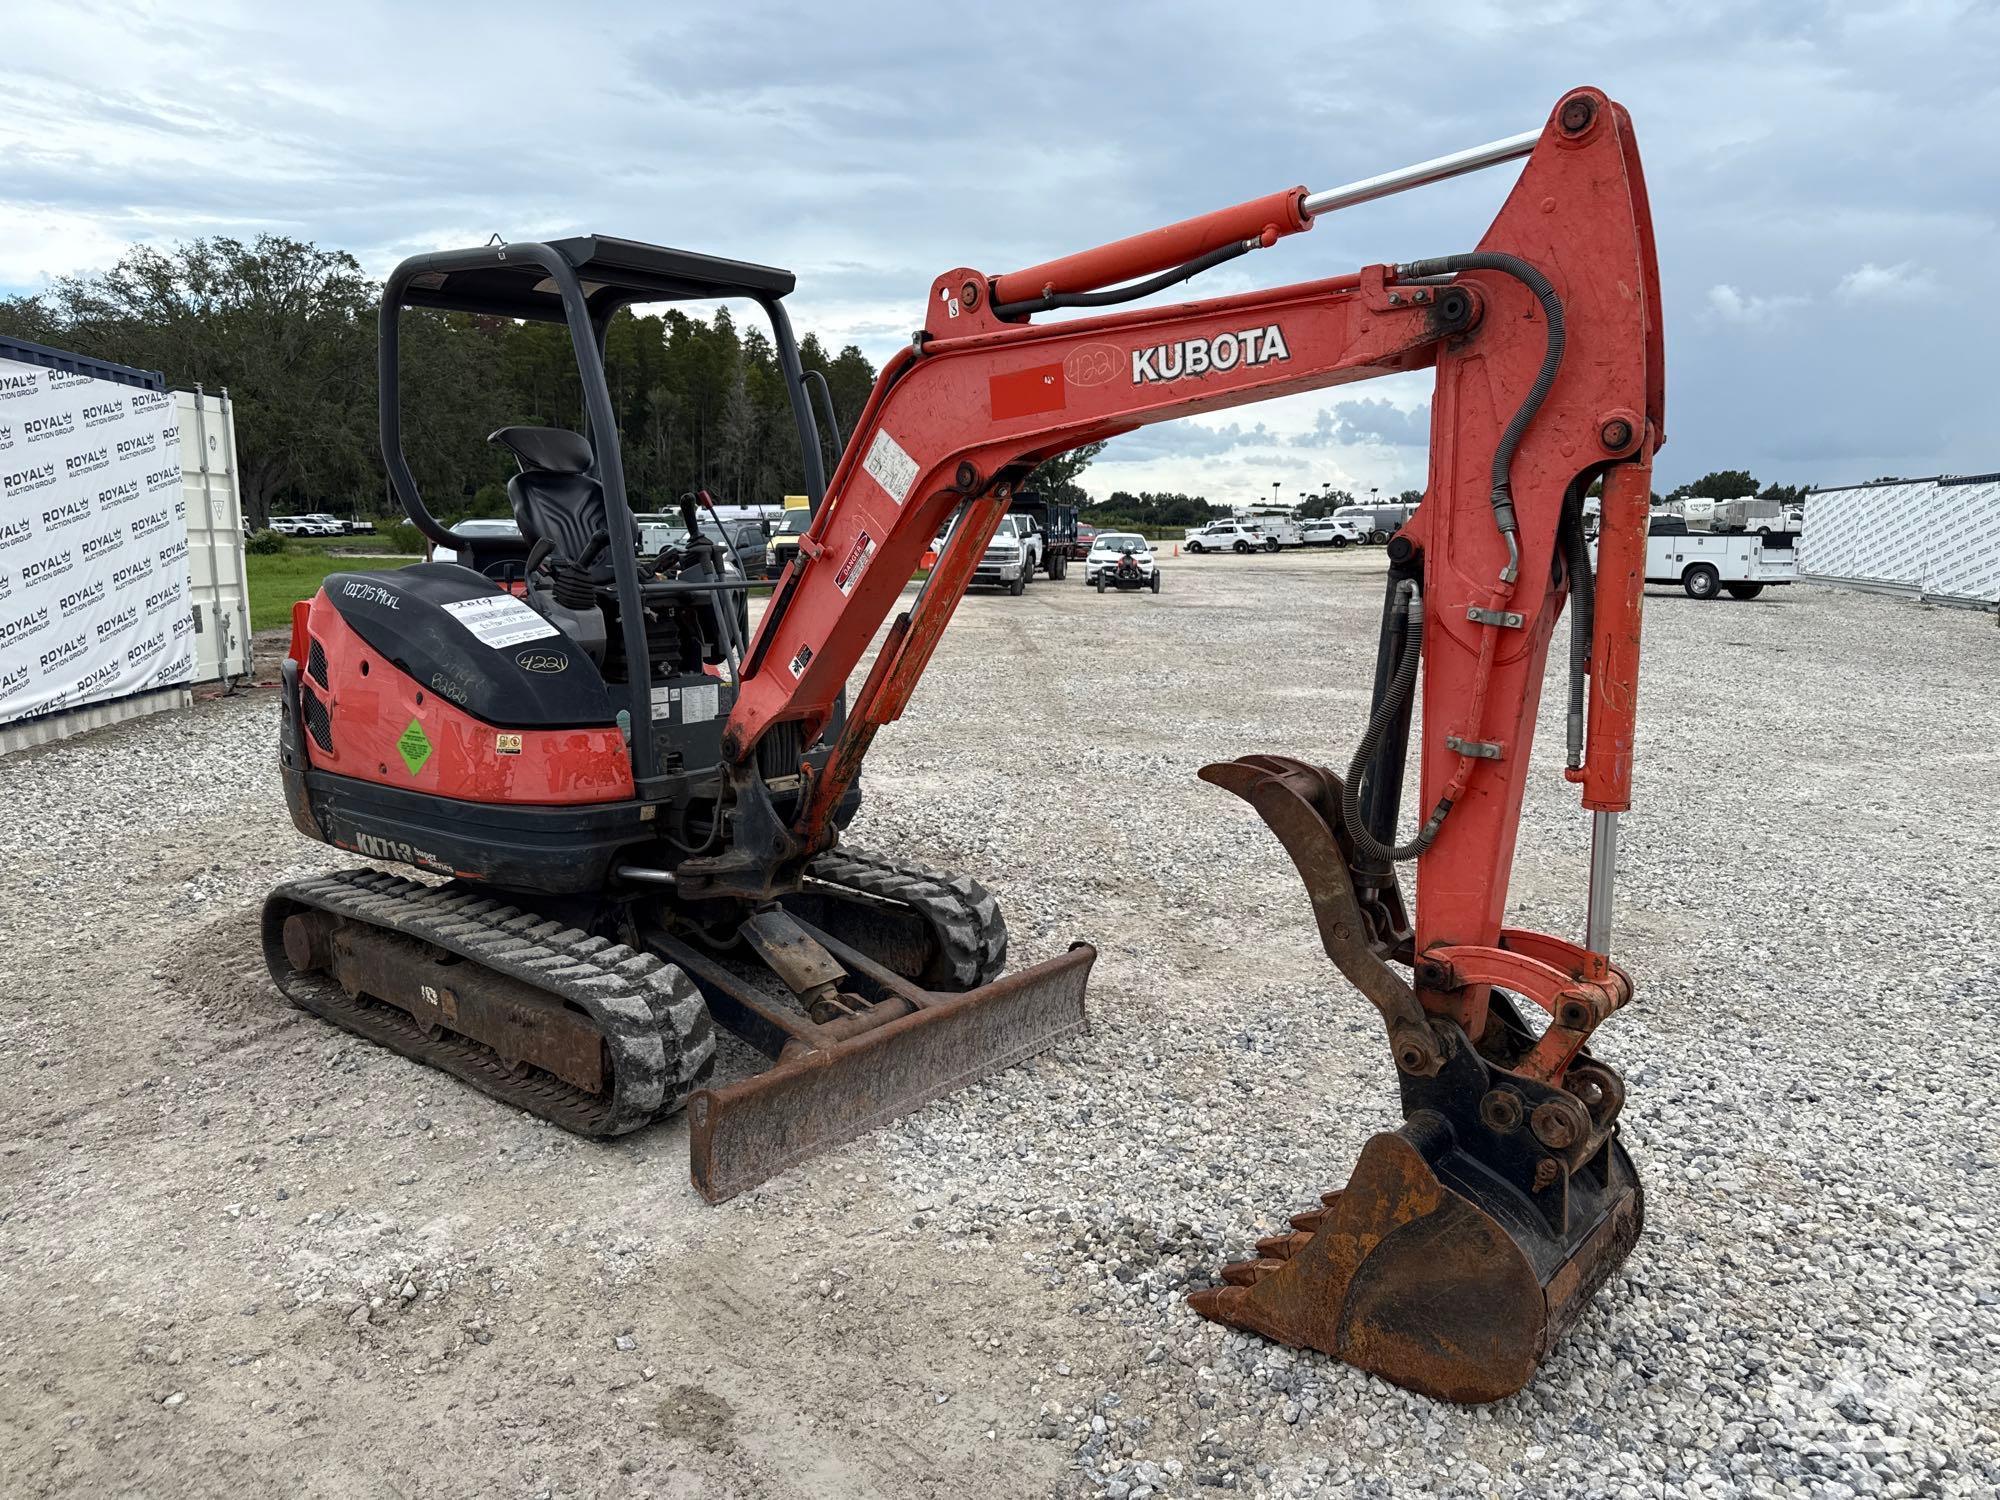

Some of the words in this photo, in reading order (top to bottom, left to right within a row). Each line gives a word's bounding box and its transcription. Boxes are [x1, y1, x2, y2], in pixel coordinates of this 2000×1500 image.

[1132, 324, 1290, 384] KUBOTA
[1068, 350, 1117, 385] 4221
[83, 403, 115, 419] ROYAL
[24, 416, 64, 434] ROYAL
[117, 436, 148, 453] ROYAL
[66, 451, 100, 470] ROYAL
[4, 468, 44, 488] ROYAL
[146, 468, 174, 485] ROYAL
[99, 484, 130, 503] ROYAL
[42, 502, 80, 524] ROYAL
[132, 513, 161, 532] ROYAL
[82, 533, 114, 555] ROYAL
[160, 541, 185, 560] ROYAL
[22, 556, 62, 579] ROYAL
[843, 544, 862, 576] DANGER
[113, 562, 144, 583] ROYAL
[60, 586, 95, 609] ROYAL
[146, 588, 173, 608] ROYAL
[453, 598, 492, 609] 2019
[97, 612, 129, 636] ROYAL
[40, 640, 78, 667] ROYAL
[128, 637, 158, 661] ROYAL
[521, 656, 565, 671] 4221
[77, 666, 111, 692] ROYAL
[356, 832, 414, 862] KX71-3
[414, 847, 436, 861] Super
